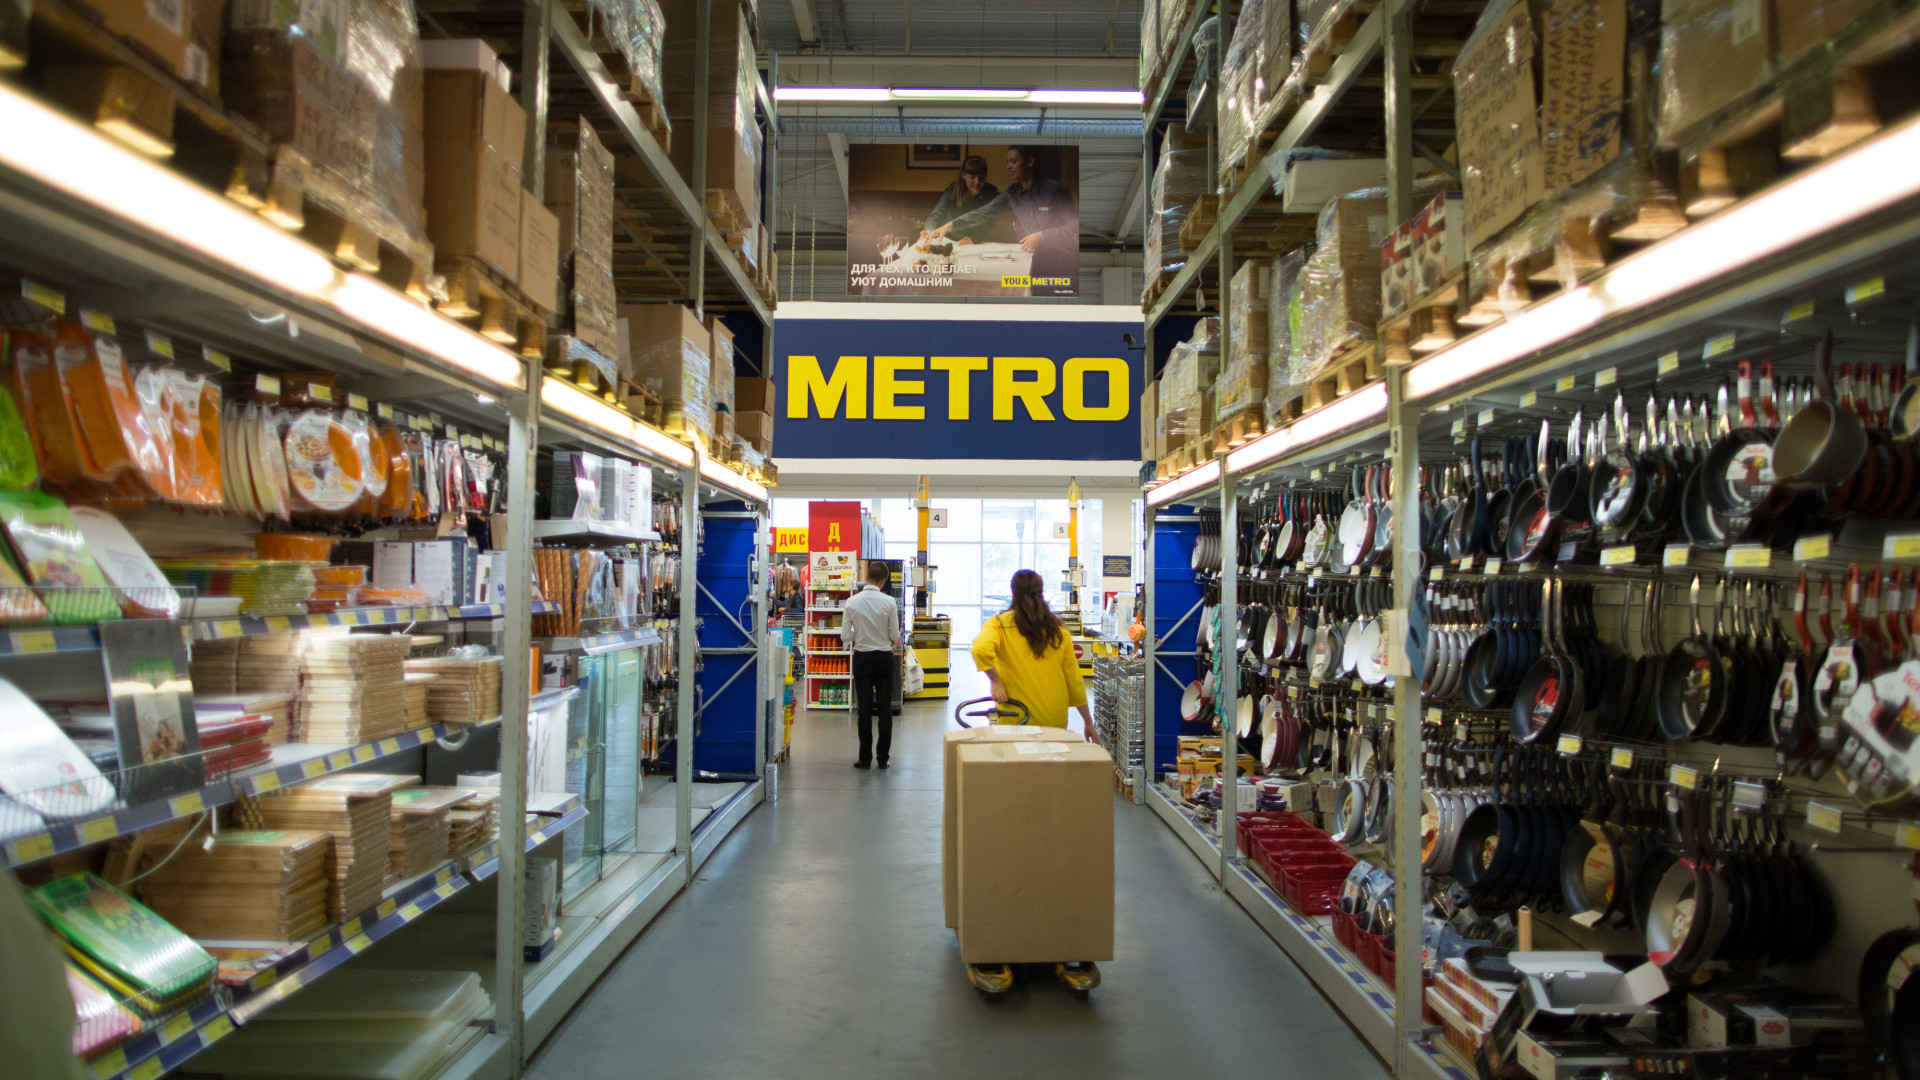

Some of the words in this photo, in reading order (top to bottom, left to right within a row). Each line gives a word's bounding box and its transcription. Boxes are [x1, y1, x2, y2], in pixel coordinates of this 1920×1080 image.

[851, 264, 876, 275] ДЛЯ
[879, 264, 904, 275] ТЕХ,
[906, 264, 930, 274] КТО
[933, 264, 978, 275] ДЕЛАЕТ
[851, 277, 877, 286] УЮТ
[879, 277, 952, 288] ДОМАШНИМ
[1004, 277, 1021, 285] YOU
[1022, 277, 1029, 285] &
[1032, 277, 1071, 286] METRO
[787, 355, 1130, 421] METRO
[933, 514, 940, 522] 4
